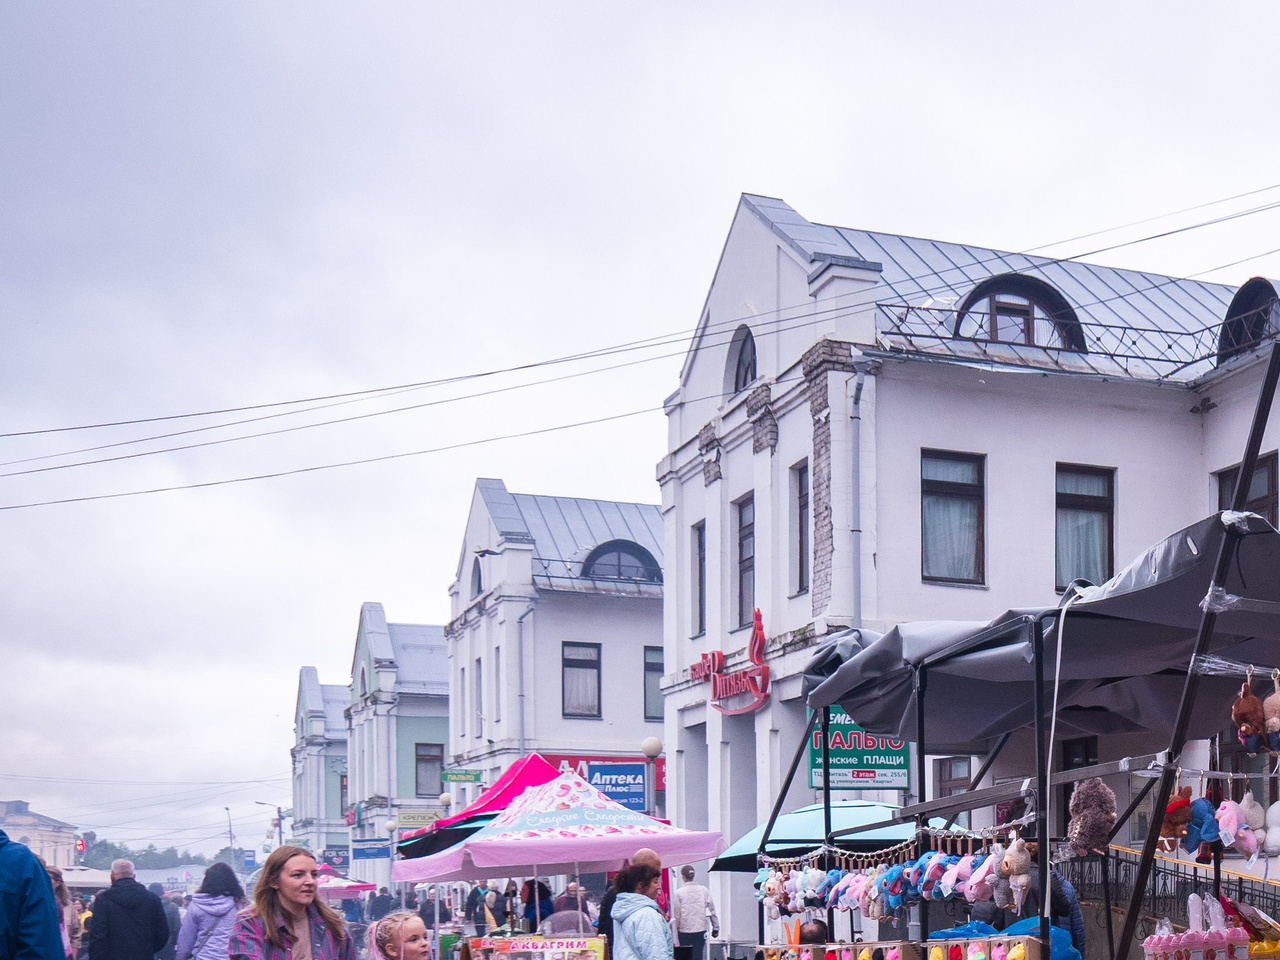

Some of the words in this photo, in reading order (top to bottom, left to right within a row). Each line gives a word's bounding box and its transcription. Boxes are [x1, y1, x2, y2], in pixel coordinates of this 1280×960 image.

[813, 731, 905, 750] ПАЛЬТО
[815, 757, 858, 765] жнские
[863, 755, 904, 766] ПЛАЩИ
[591, 772, 643, 784] Аптека
[526, 812, 580, 827] Сладкие
[584, 806, 645, 823] Сладости
[510, 941, 587, 950] АКВАГРИМ
